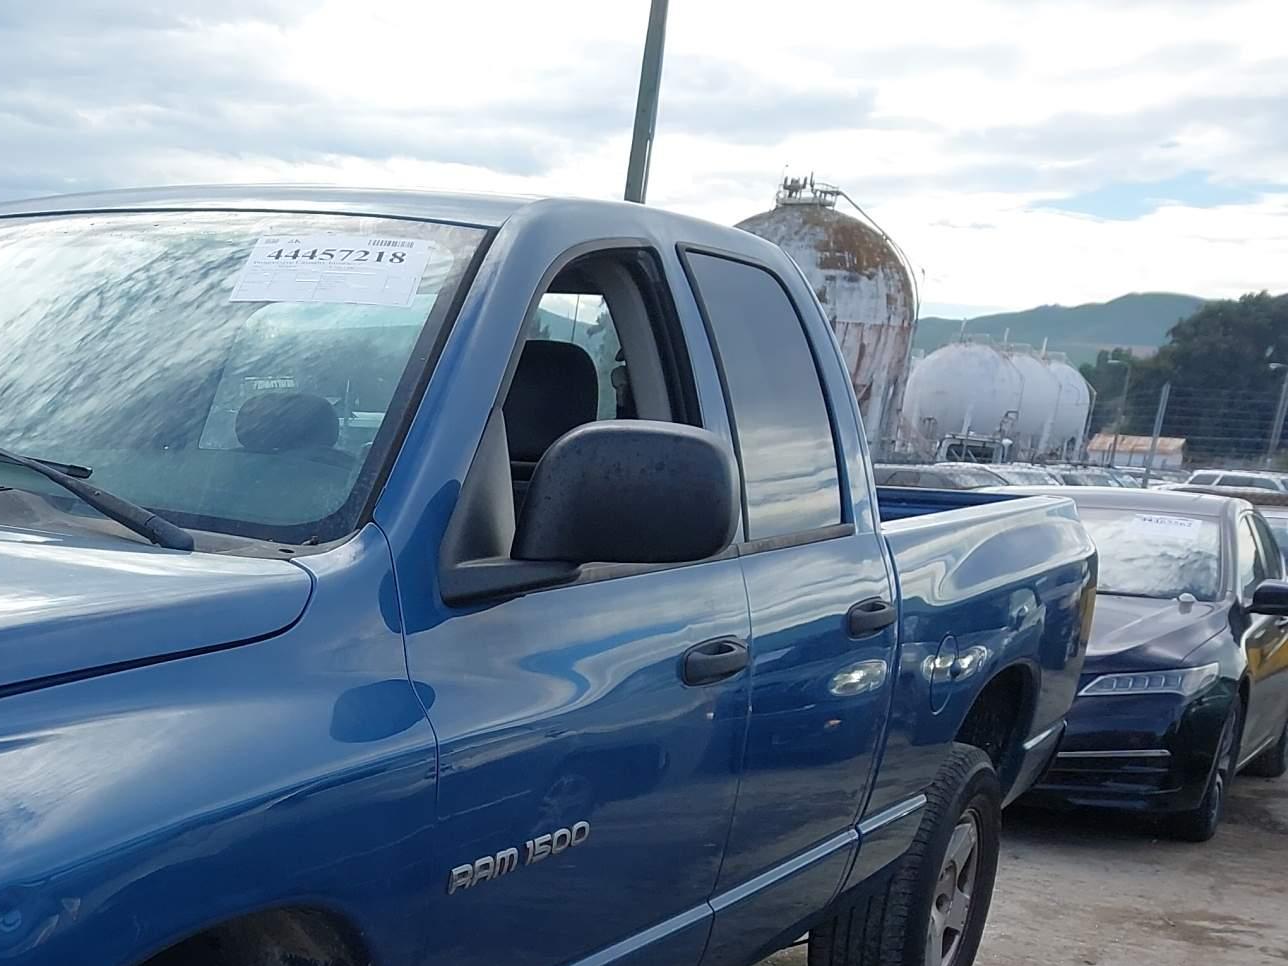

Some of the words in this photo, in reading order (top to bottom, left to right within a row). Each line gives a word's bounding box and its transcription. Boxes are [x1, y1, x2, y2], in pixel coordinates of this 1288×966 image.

[266, 248, 407, 264] 44457218
[447, 847, 519, 895] RAM
[525, 820, 591, 866] 1500
